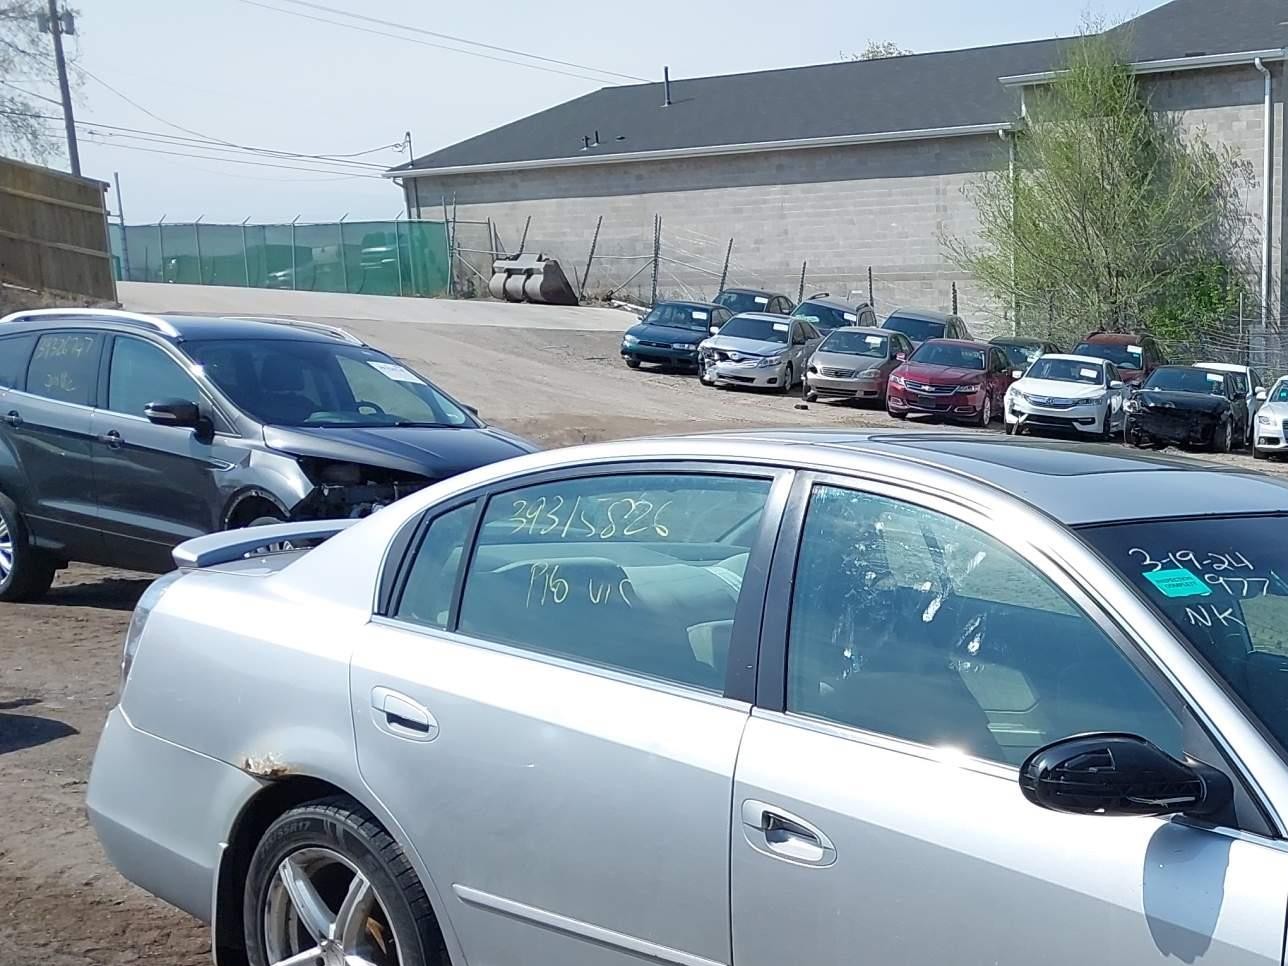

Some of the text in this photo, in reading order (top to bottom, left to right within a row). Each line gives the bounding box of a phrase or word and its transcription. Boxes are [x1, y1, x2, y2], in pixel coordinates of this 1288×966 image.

[508, 495, 673, 539] 39315826
[1128, 548, 1254, 573] 3-19-24
[1204, 573, 1269, 597] 977
[1185, 604, 1247, 627] NK
